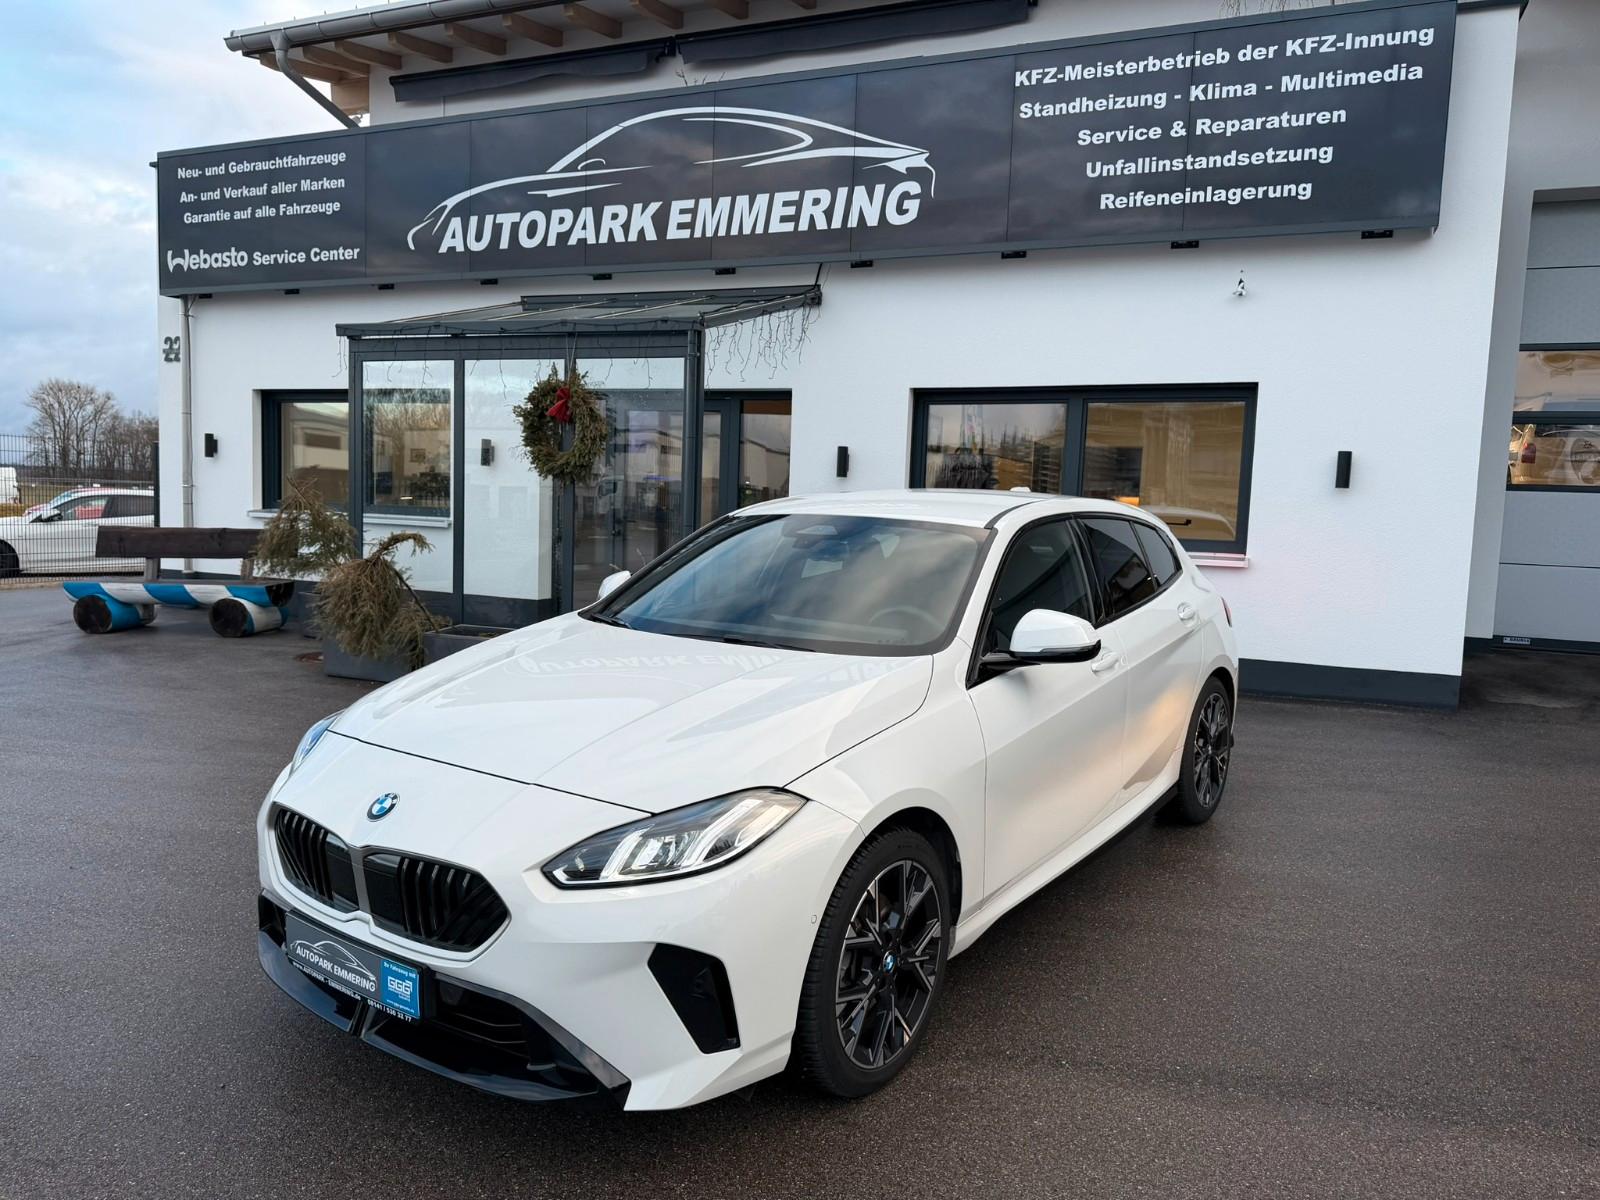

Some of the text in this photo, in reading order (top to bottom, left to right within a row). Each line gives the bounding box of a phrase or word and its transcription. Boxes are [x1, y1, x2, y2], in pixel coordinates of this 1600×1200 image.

[1015, 27, 1435, 87] KFZ-Meisterbetrieb der KFZ-Innung
[1019, 92, 1167, 119] Standheizung
[1190, 83, 1257, 101] Klima
[1280, 63, 1423, 93] Multimedia
[1077, 109, 1347, 146] Service & Reparaturen
[177, 151, 347, 179] Neu- und Gebrauchtfahrzeuge
[1086, 144, 1334, 178] Unfallinstandsetzung
[179, 176, 346, 204] An- und Verkauf aller Marken
[1100, 181, 1313, 210] Reifeneinlagerung
[183, 201, 341, 224] Garantie auf alle Fahrzeuge
[438, 180, 922, 254] AUTOPARK EMMERING
[167, 246, 361, 273] Webasto Service Center
[296, 946, 376, 992] AUTOPARK EMMERING
